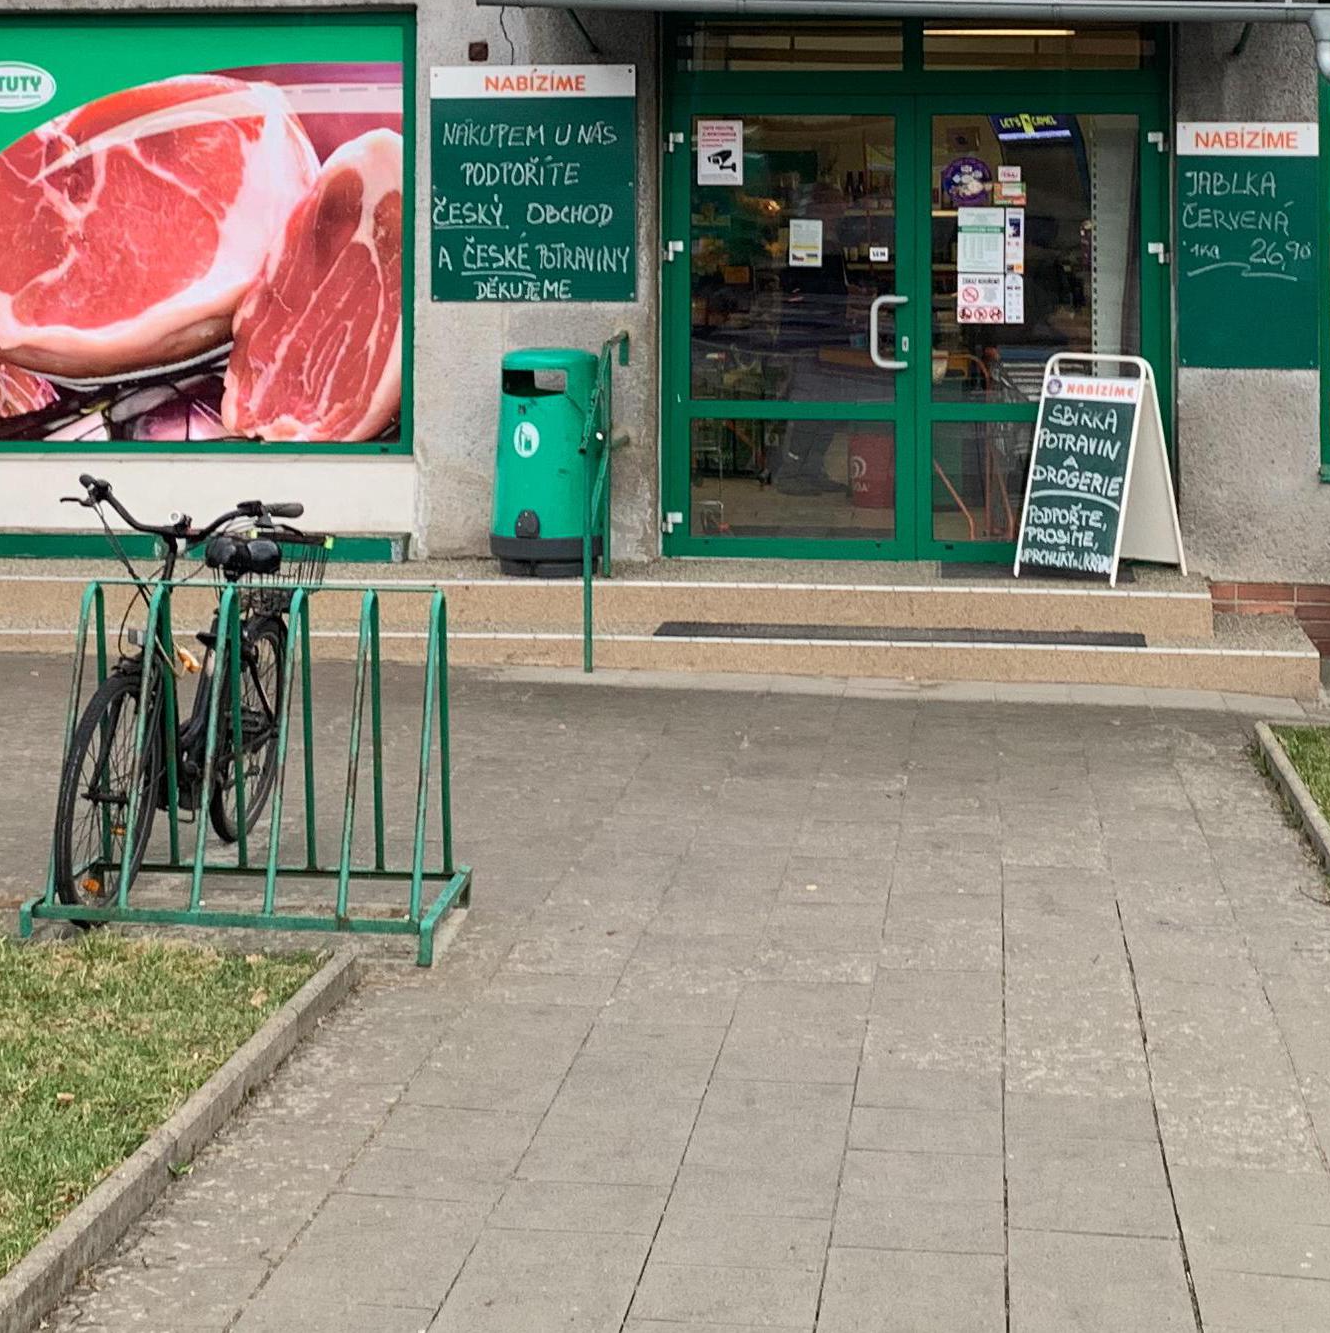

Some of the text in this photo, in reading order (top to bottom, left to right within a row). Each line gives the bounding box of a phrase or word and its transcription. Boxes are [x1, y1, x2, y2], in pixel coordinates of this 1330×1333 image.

[484, 71, 586, 93] NABÍZÍME
[443, 119, 618, 148] NÁKUPEM U NÁS
[1194, 127, 1298, 150] NABÍZÍME
[460, 155, 580, 186] PODPOŘÍTE
[1185, 170, 1277, 198] JABLKA
[433, 193, 613, 227] ČESKÝ OBCHOD
[1182, 201, 1294, 236] ČERVENÁ
[438, 232, 630, 274] A ČESKÉ POTRAVINY
[474, 277, 572, 301] DĚKUJEME
[1066, 383, 1135, 398] NABÍZÍME
[1048, 402, 1118, 434] SBÍRKA
[1038, 427, 1121, 461] POTRAVIN
[1062, 455, 1079, 469] A
[1031, 464, 1123, 497] DROGERIE
